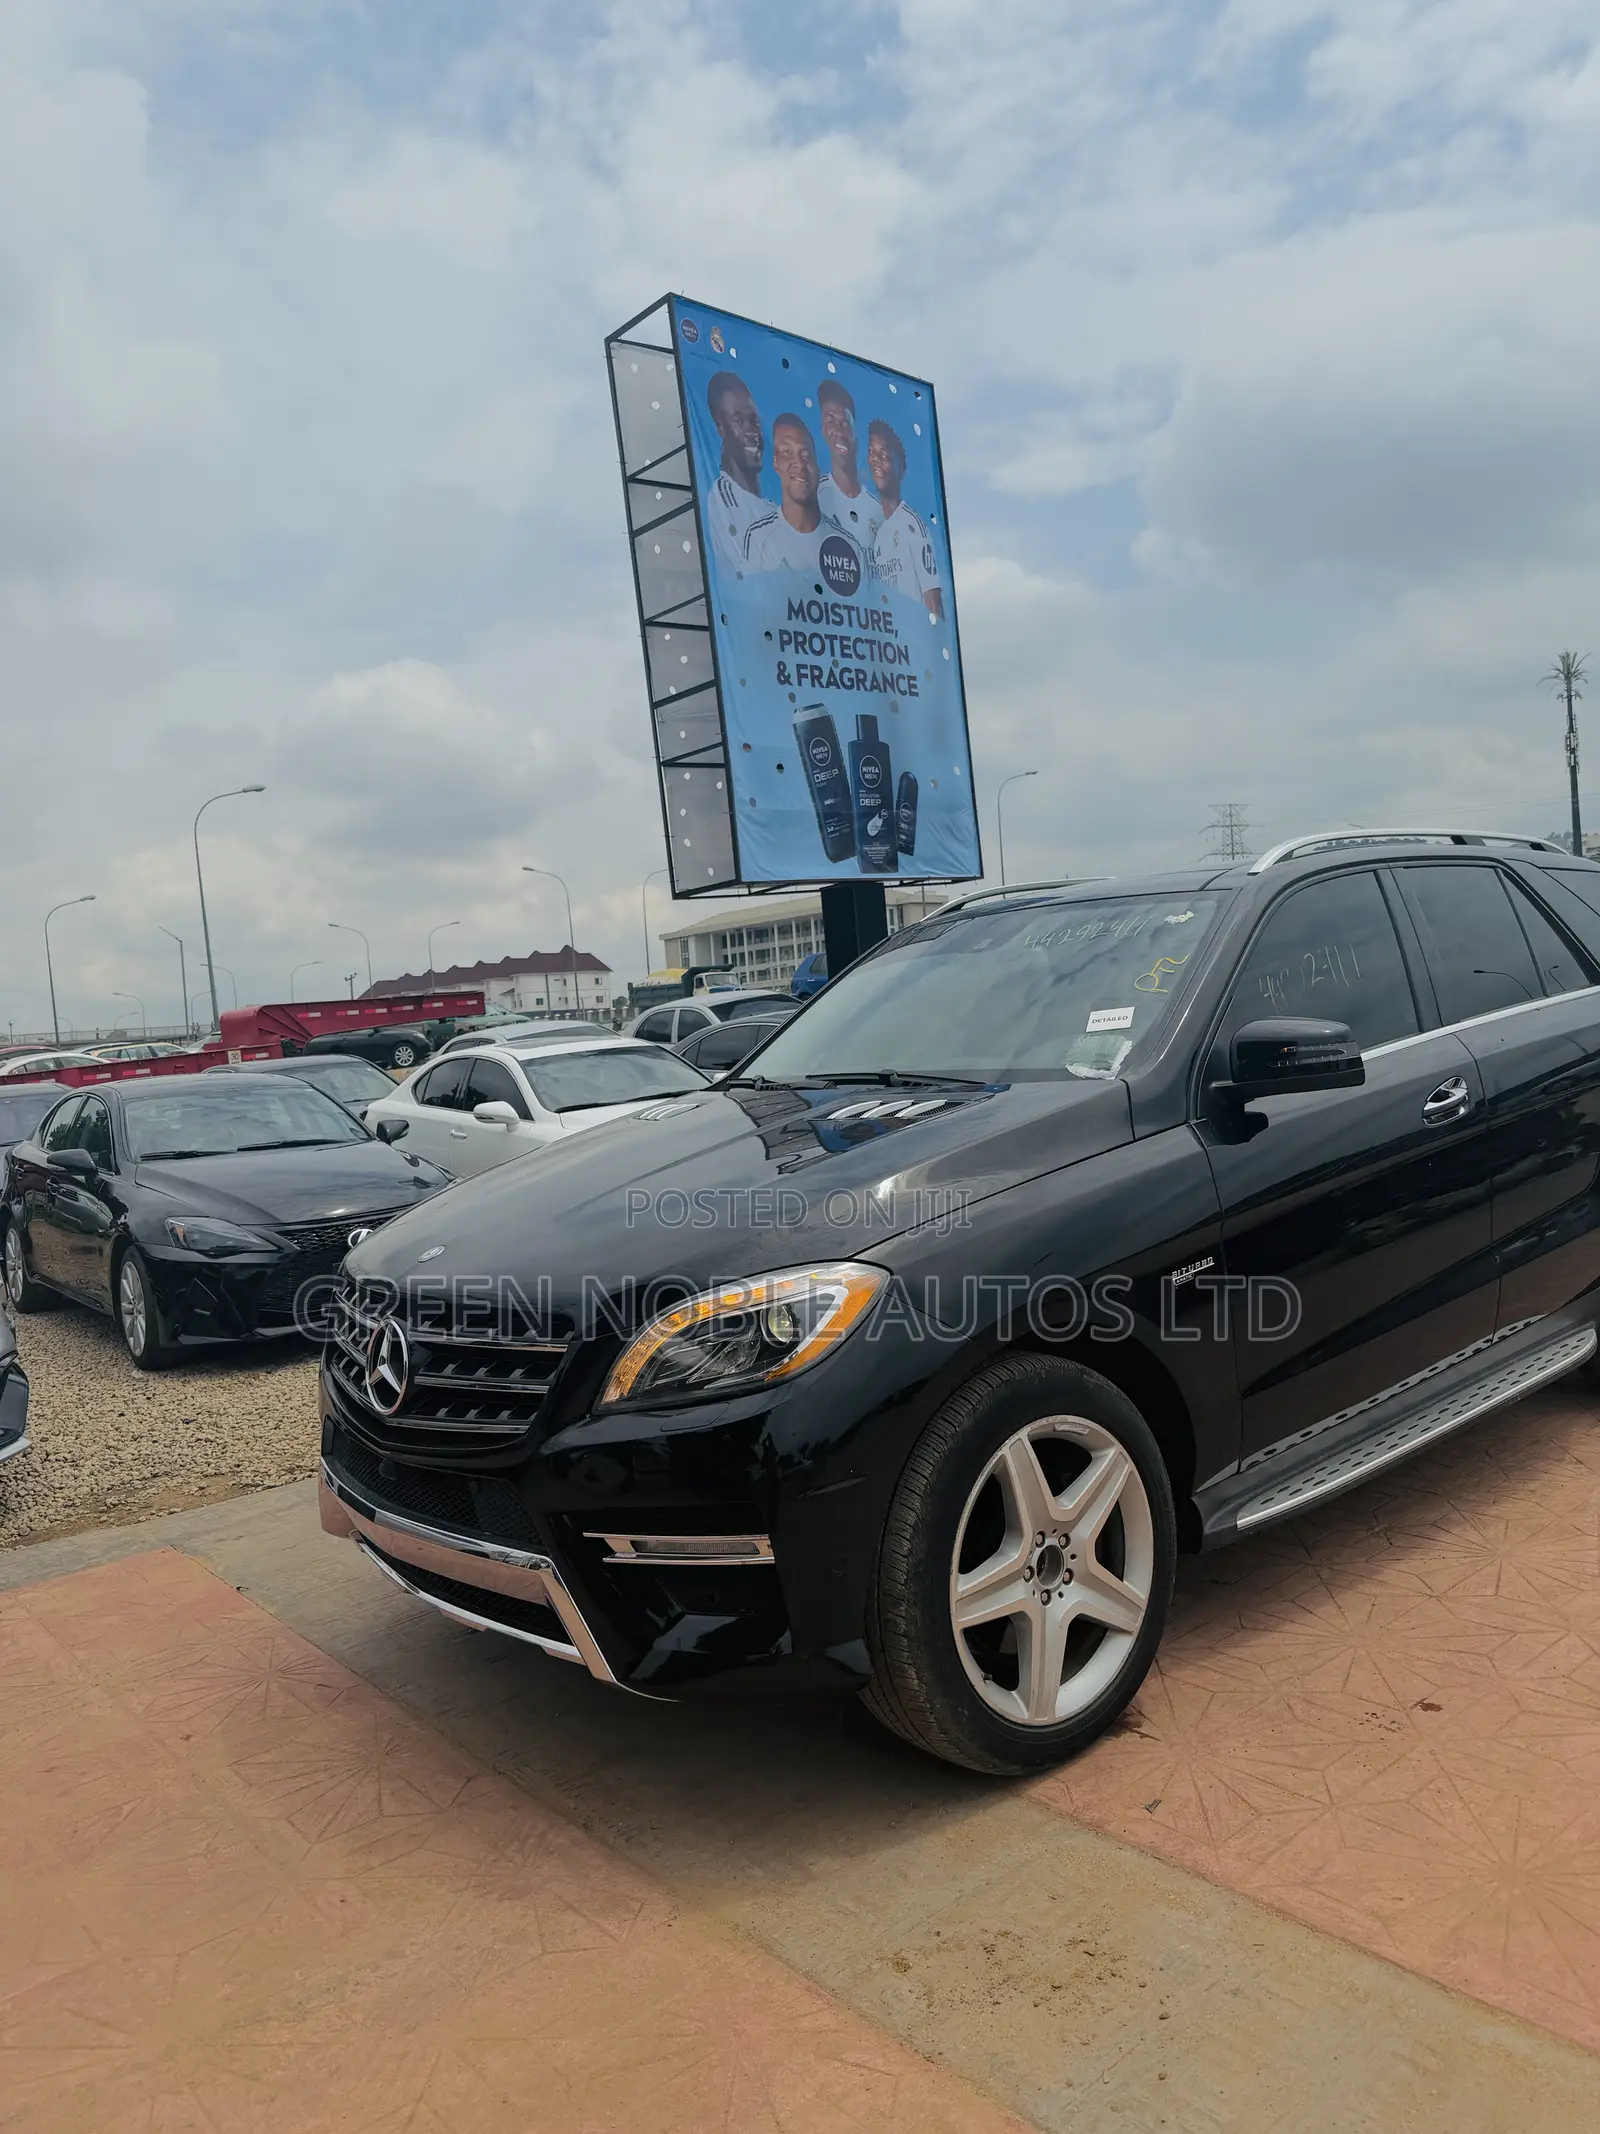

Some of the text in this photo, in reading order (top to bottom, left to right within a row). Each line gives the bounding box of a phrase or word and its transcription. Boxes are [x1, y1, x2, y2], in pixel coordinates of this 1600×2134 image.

[823, 554, 857, 572] NIVEA
[829, 571, 854, 583] MEN
[787, 597, 898, 639] MOISTURE,
[778, 629, 910, 667] PROTECTION
[776, 660, 920, 698] & FRAGRANCE
[813, 768, 839, 783] DEEP
[860, 798, 882, 806] DEEP
[1024, 914, 1156, 949] 44292411
[1091, 1015, 1129, 1024] DETAILED
[1172, 1256, 1214, 1279] BITURBO
